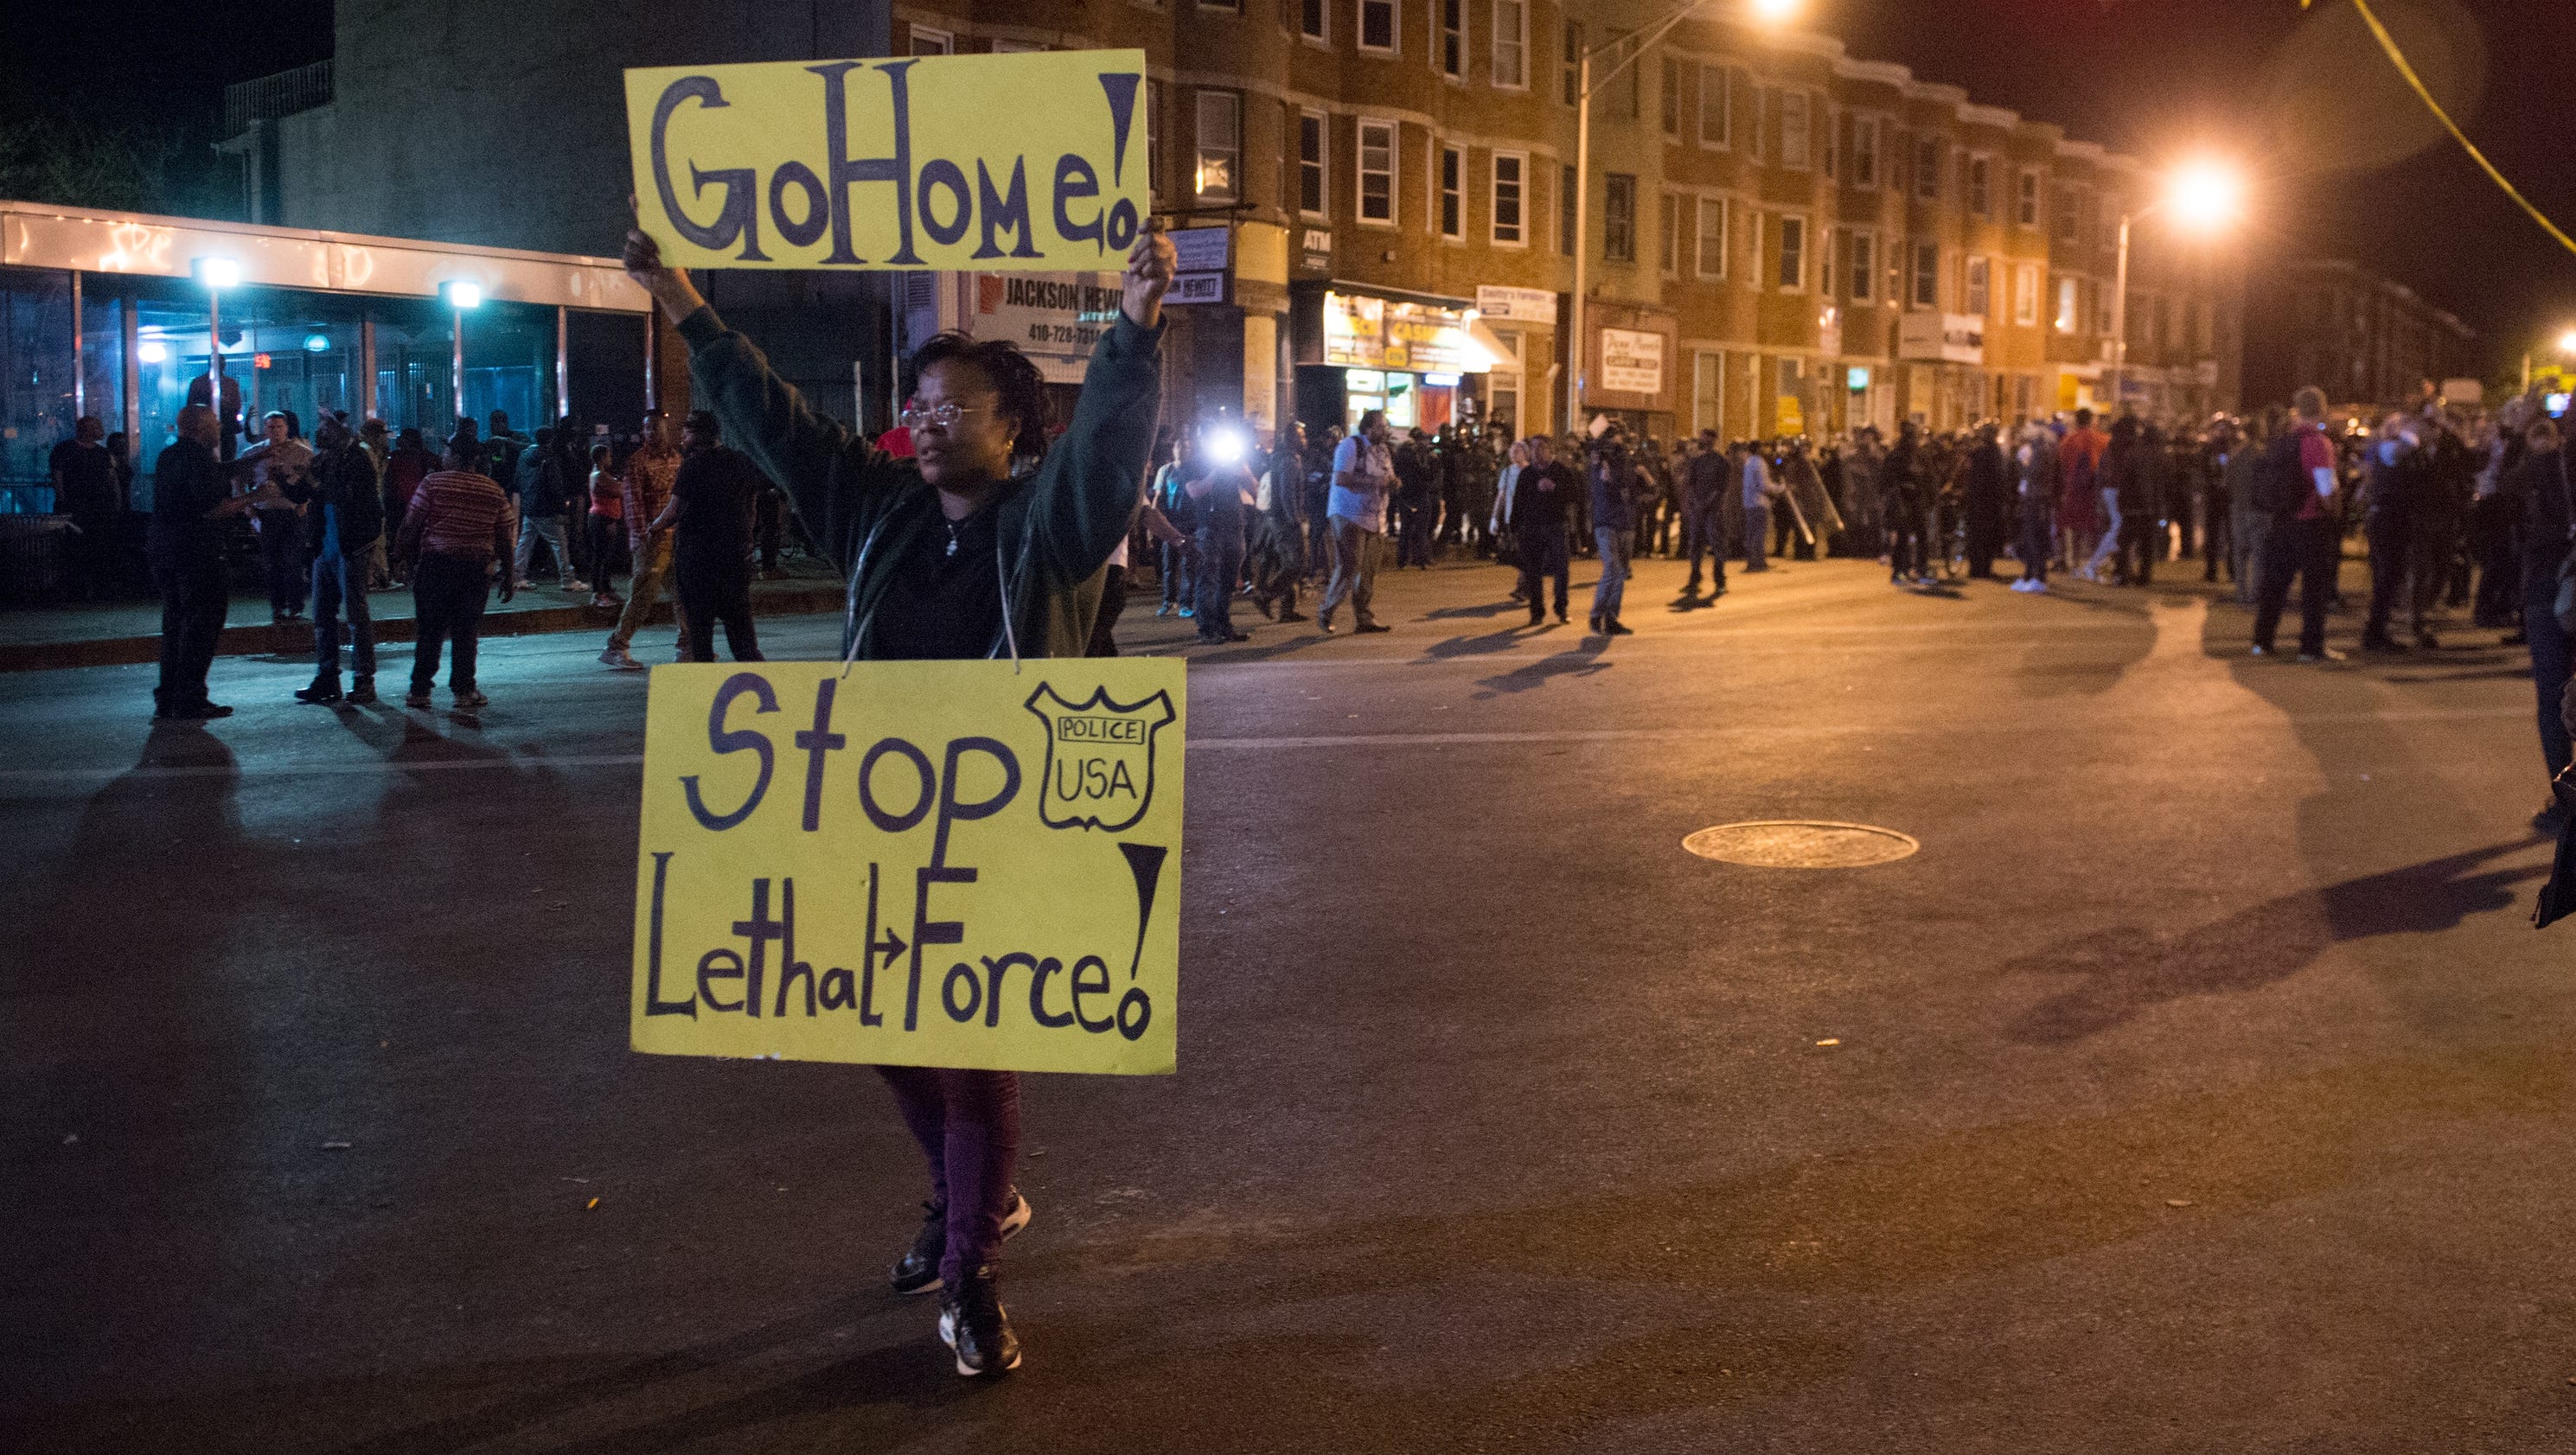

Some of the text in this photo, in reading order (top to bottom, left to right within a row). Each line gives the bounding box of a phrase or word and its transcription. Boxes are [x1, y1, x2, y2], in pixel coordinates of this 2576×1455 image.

[1007, 277, 1078, 312] JACKSON
[1064, 718, 1137, 739] POLICE
[680, 673, 1021, 868] Stop
[1057, 758, 1137, 801] USA
[645, 842, 1168, 1041] Lethal Force!
